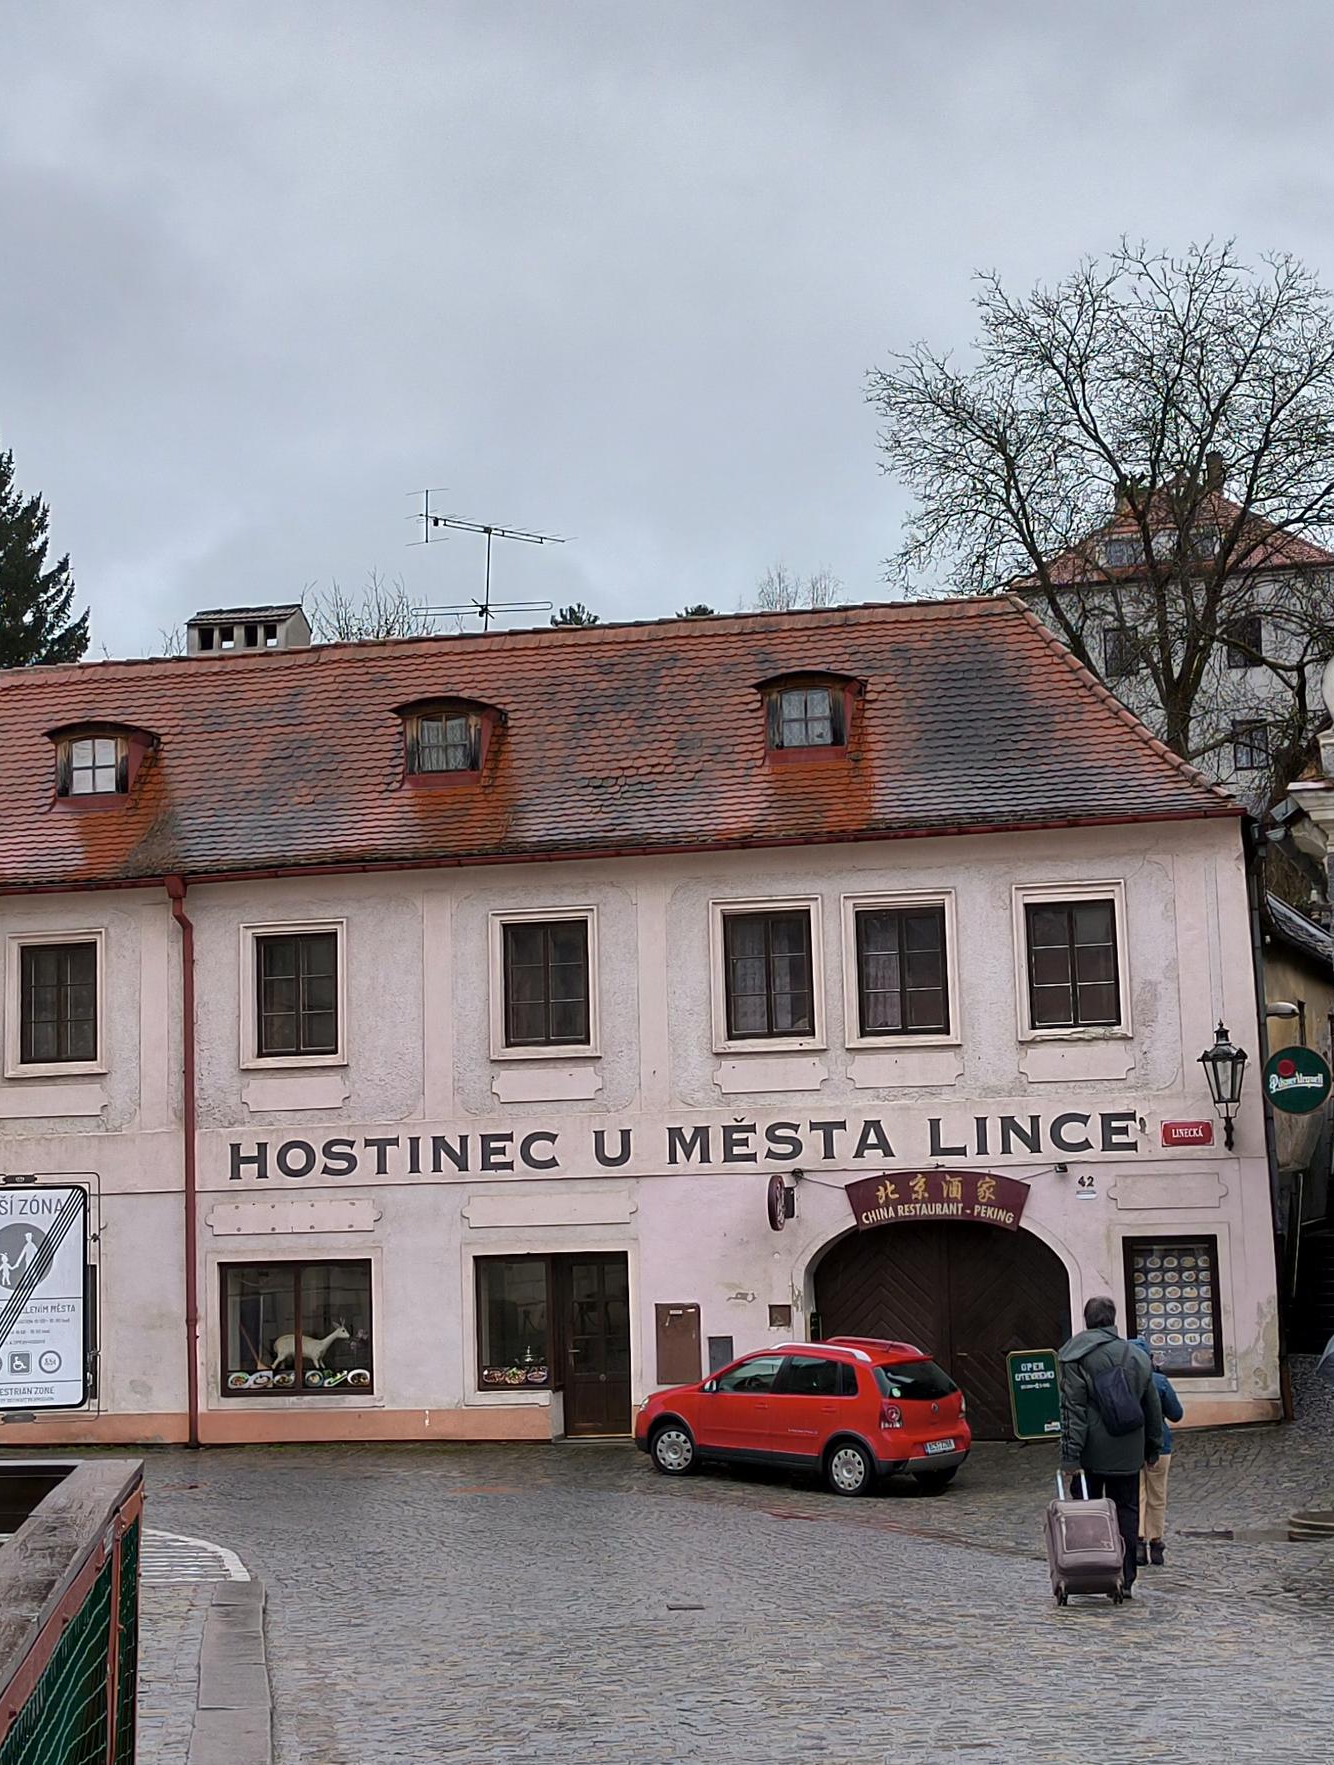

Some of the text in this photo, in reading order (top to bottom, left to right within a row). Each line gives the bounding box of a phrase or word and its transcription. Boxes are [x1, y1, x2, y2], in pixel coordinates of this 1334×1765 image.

[1171, 1125, 1204, 1139] LINECKÁ
[229, 1109, 1140, 1180] HOSTINEC U MĚSTA LINCE
[875, 1173, 999, 1204] 北京酒家
[1077, 1175, 1095, 1188] 42
[18, 1194, 64, 1216] ZÓNA
[861, 1206, 896, 1225] CHINA
[897, 1202, 964, 1217] RESTAURANT
[973, 1204, 1015, 1225] PEKING
[1021, 1362, 1044, 1372] OPEN
[34, 1386, 55, 1395] ZONE
